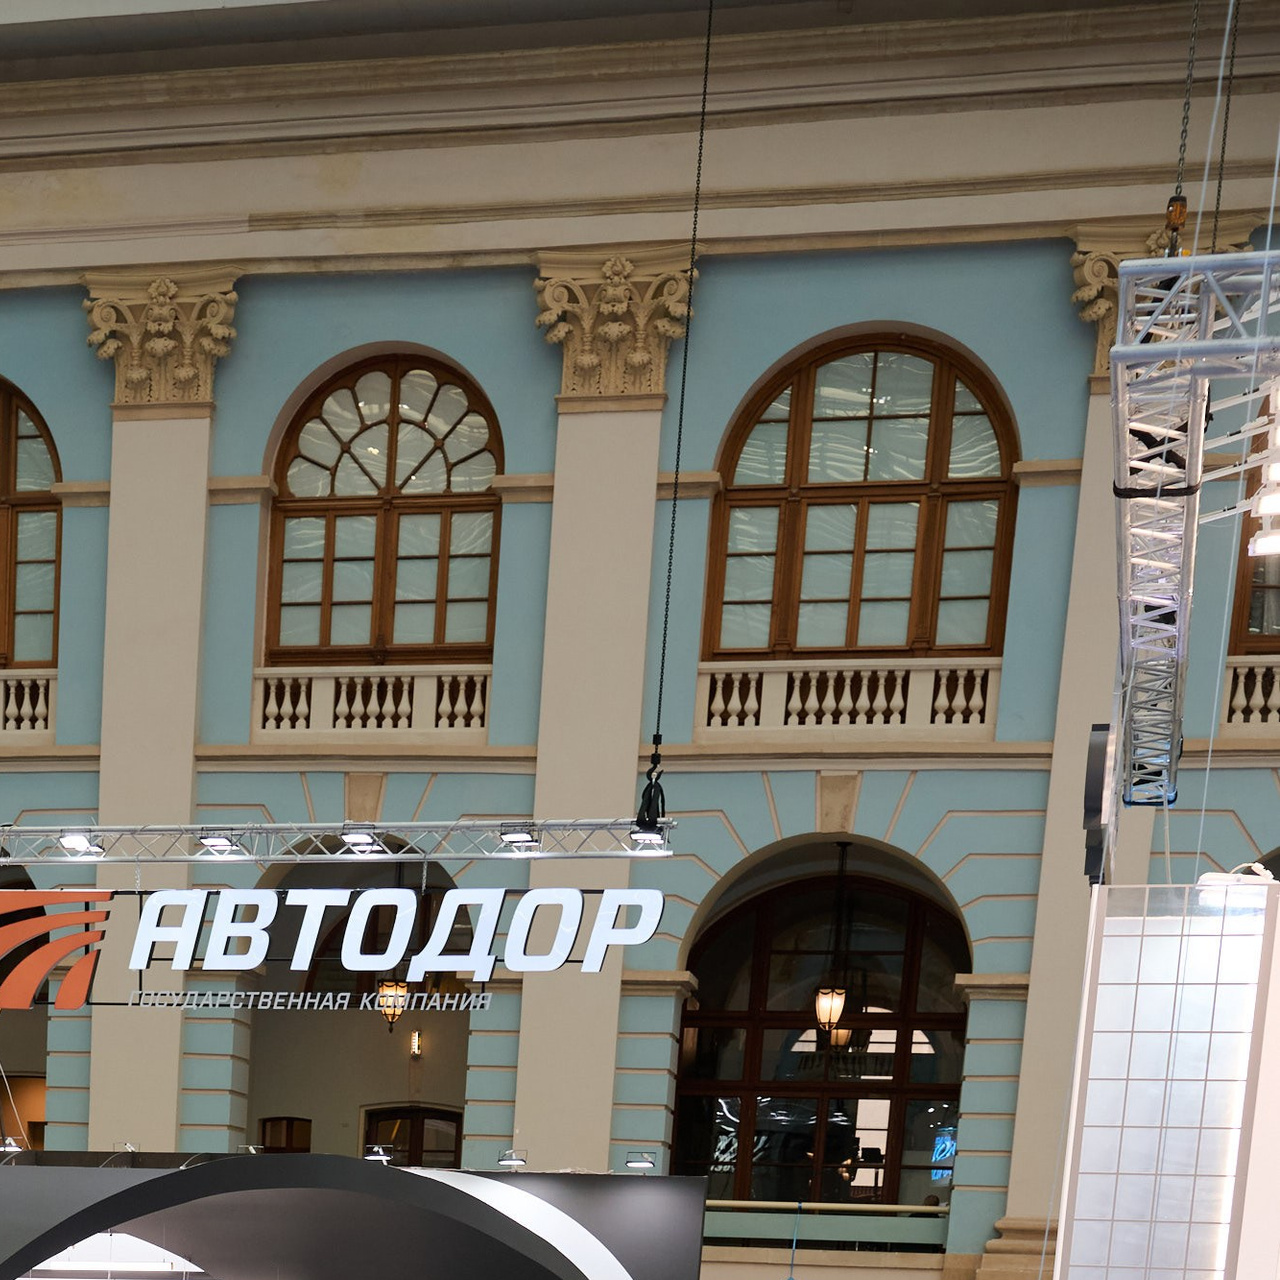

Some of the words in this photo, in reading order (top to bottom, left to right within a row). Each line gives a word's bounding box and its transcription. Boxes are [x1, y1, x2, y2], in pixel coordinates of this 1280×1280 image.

[128, 888, 665, 983] АВТОДОР
[128, 990, 350, 1011] ГОСУДАРСТВЕННАЯ
[358, 991, 493, 1012] КОМПАНИЯ
